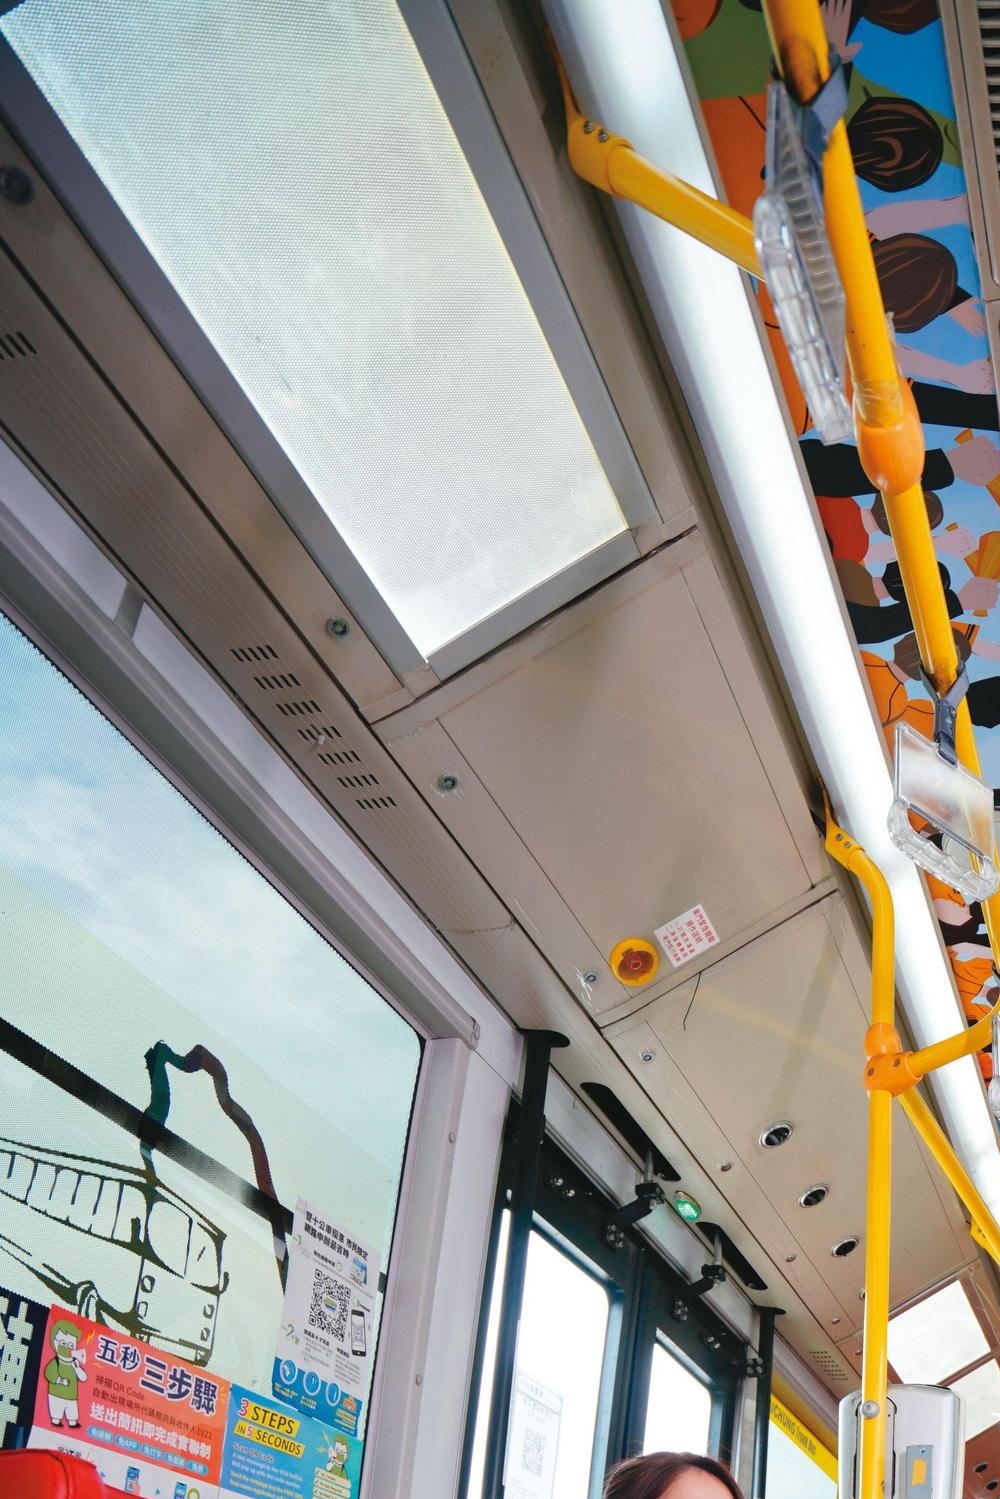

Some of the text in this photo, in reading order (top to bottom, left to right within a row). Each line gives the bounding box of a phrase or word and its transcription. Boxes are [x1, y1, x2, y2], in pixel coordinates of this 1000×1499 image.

[126, 1385, 145, 1400] Code
[239, 1399, 295, 1435] 3 STEPS
[237, 1424, 302, 1456] IN 5 SECONDS
